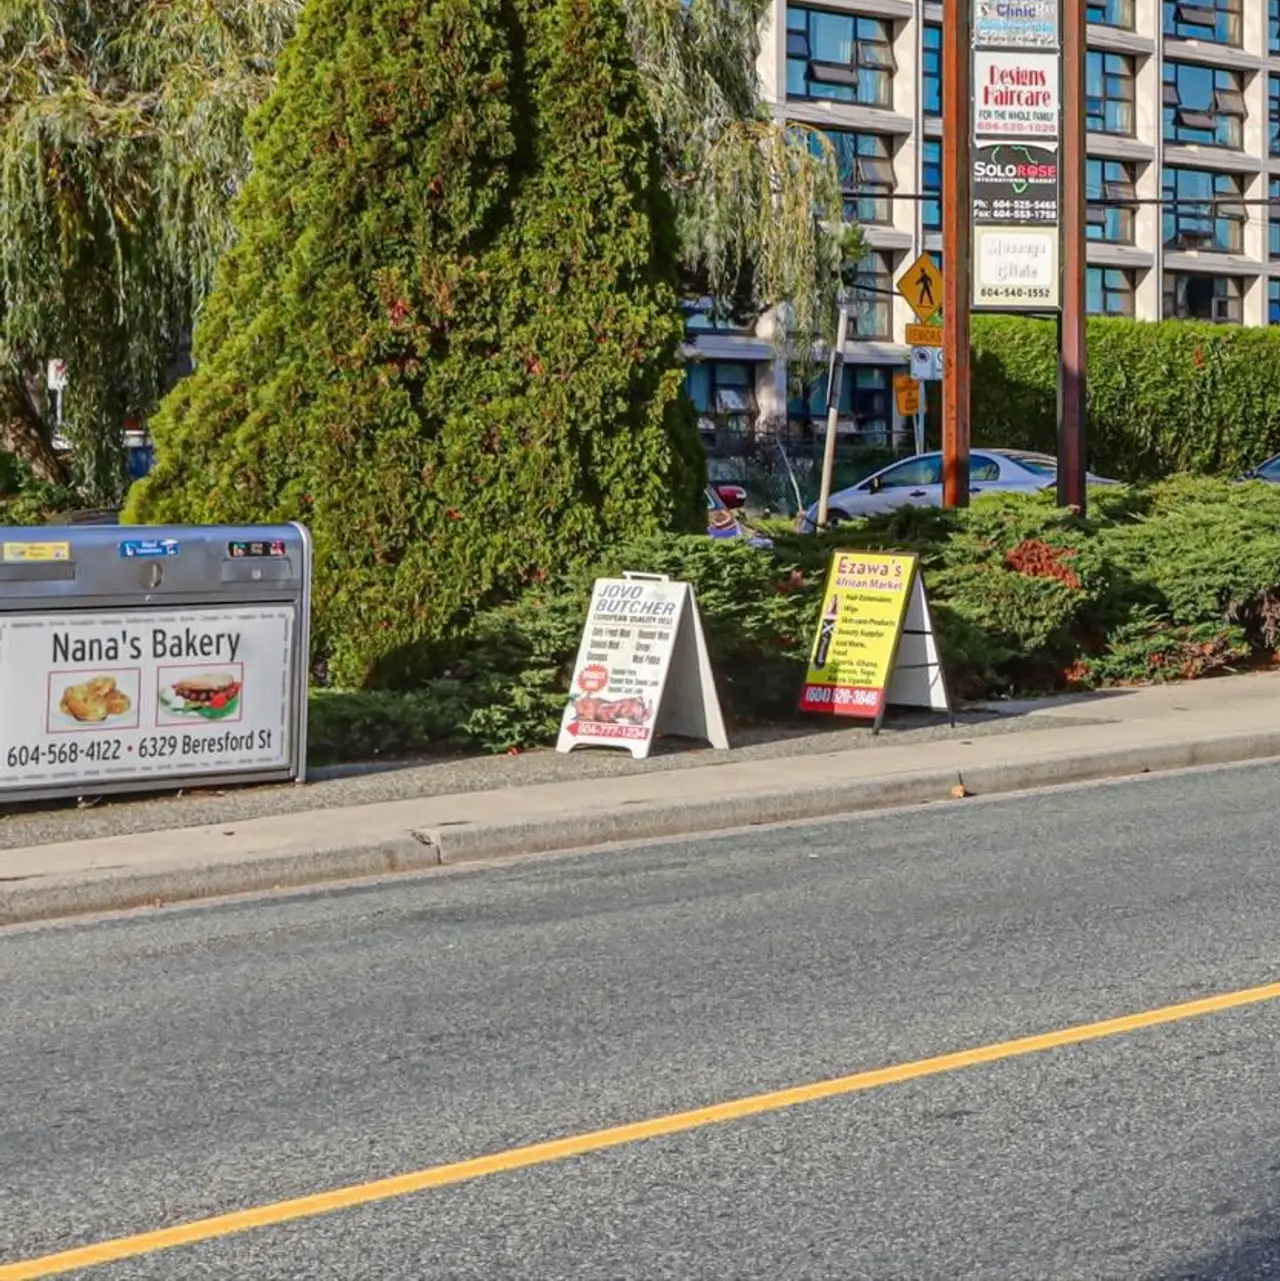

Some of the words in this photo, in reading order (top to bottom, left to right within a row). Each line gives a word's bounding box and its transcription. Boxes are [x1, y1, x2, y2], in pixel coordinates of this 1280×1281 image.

[996, 4, 1037, 17] Clinic
[989, 65, 1046, 86] Designs
[979, 110, 992, 120] FOR
[994, 110, 1006, 120] THE
[1008, 111, 1031, 120] WHOLE
[838, 556, 902, 577] Ezawa's
[598, 584, 644, 599] JOVO
[836, 576, 868, 588] African
[869, 579, 903, 590] Market
[595, 599, 676, 616] BUTCHER
[52, 630, 143, 663] Nana's
[152, 628, 242, 662] Bakery
[7, 739, 122, 767] 604-568-4122
[138, 736, 177, 758] 6329
[182, 731, 254, 755] Beresford
[258, 729, 272, 749] St
